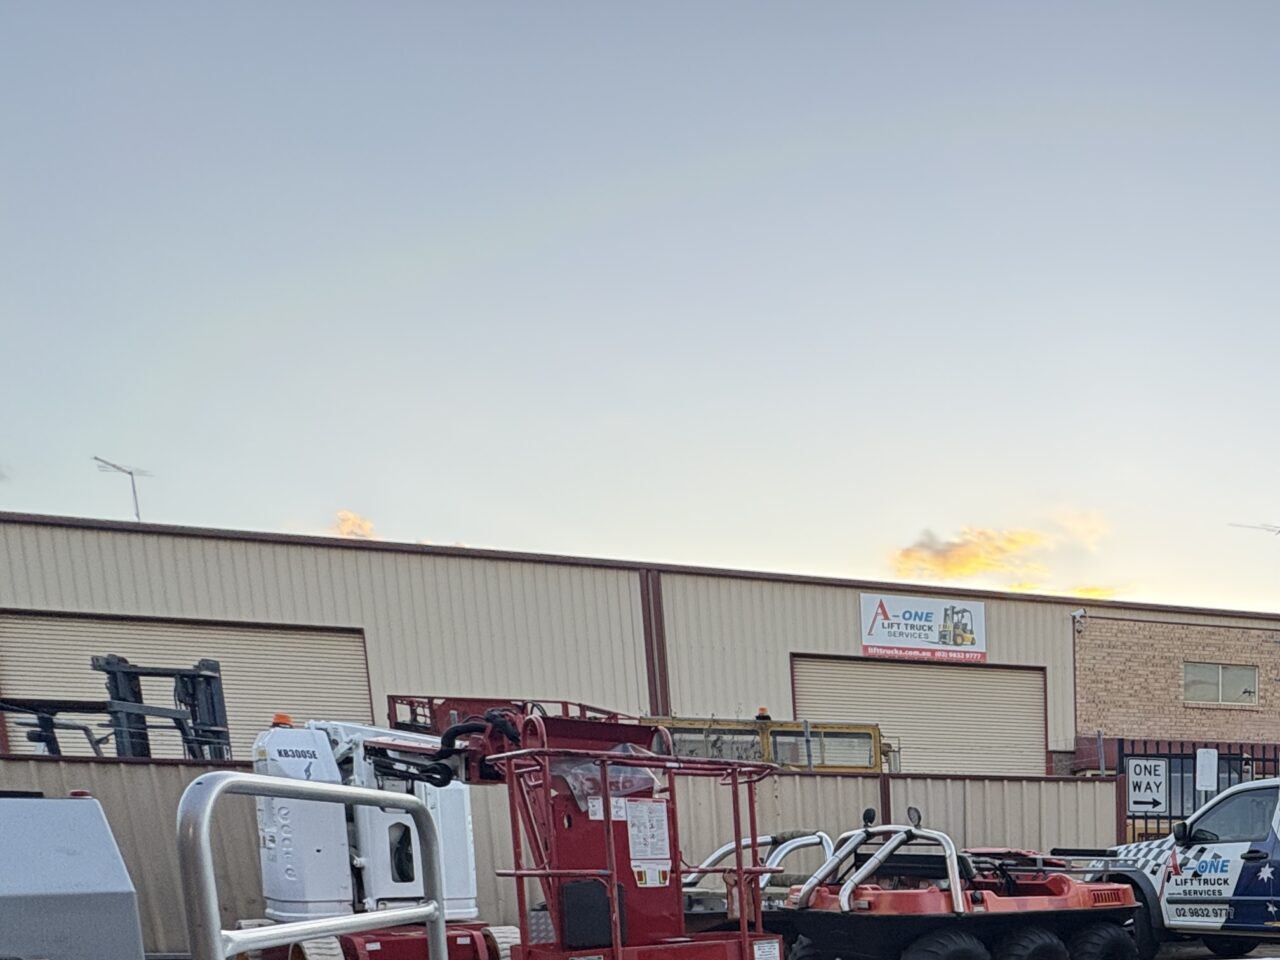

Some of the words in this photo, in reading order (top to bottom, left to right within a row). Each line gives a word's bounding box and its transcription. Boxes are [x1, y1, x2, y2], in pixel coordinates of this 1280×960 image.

[868, 599, 934, 636] A-ONE
[881, 622, 901, 630] LIFT
[904, 623, 934, 632] TRUCK
[887, 631, 929, 640] SERVICES
[1133, 763, 1161, 777] ONE
[1132, 780, 1163, 794] WAY
[1174, 878, 1198, 887] LIFT
[1198, 877, 1230, 887] TRUCK
[1182, 889, 1223, 897] SERVICES
[1175, 907, 1187, 918] 02
[1188, 908, 1211, 918] 9832
[1212, 907, 1236, 919] 9777
